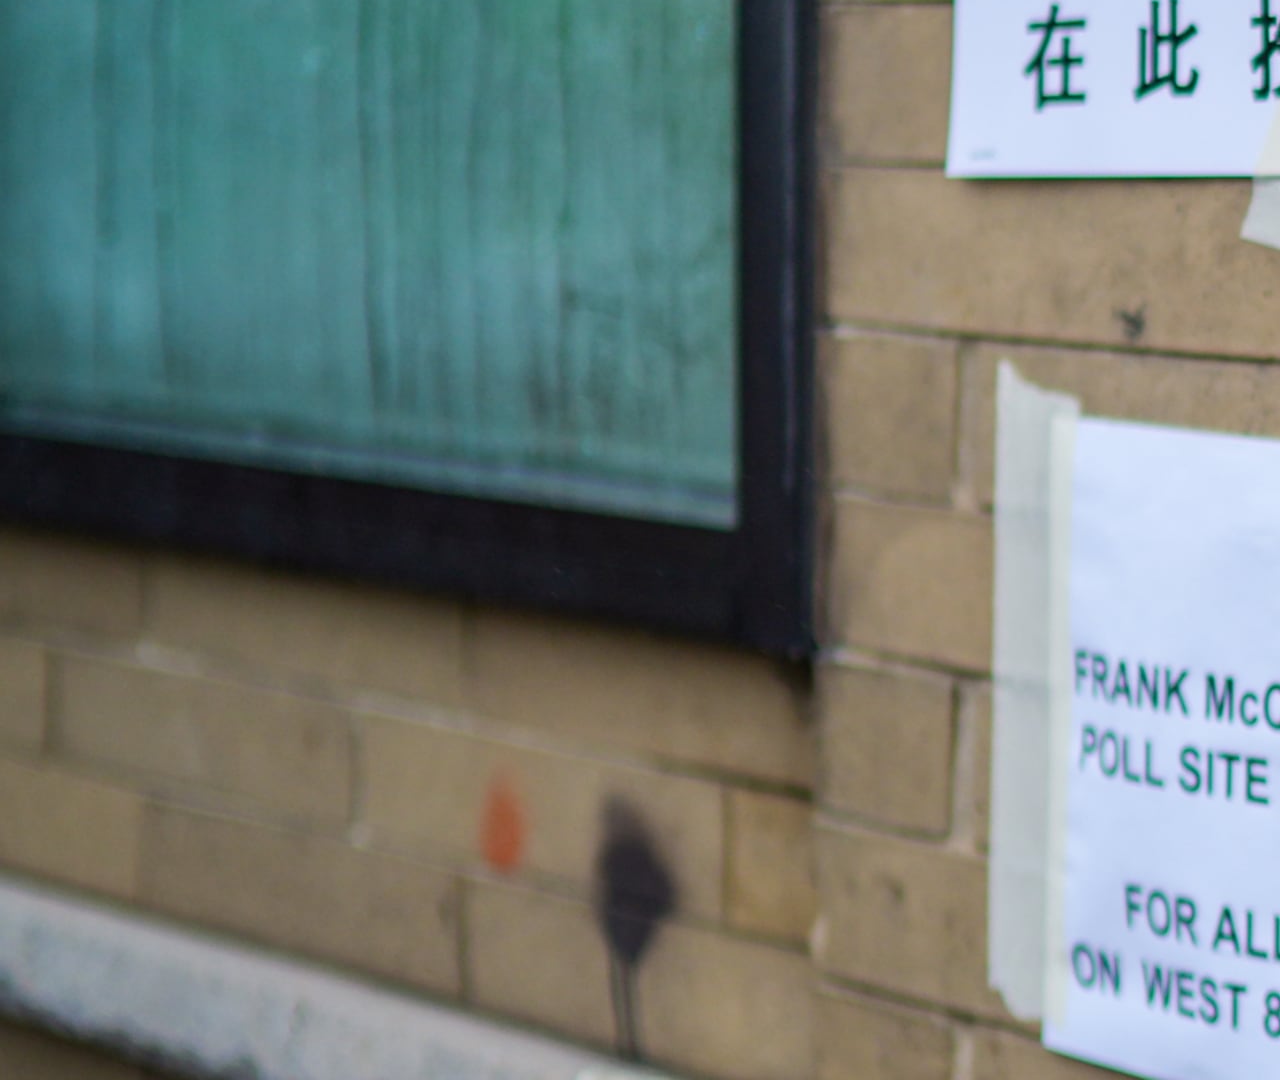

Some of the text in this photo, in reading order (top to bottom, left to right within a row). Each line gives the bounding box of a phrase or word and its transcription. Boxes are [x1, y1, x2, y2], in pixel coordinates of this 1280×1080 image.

[1073, 648, 1190, 717] FRANK
[1078, 723, 1165, 790] POLL
[1177, 745, 1270, 806] SITE
[1123, 883, 1198, 944] FOR
[1071, 942, 1122, 996] ON
[1142, 955, 1248, 1032] WEST
